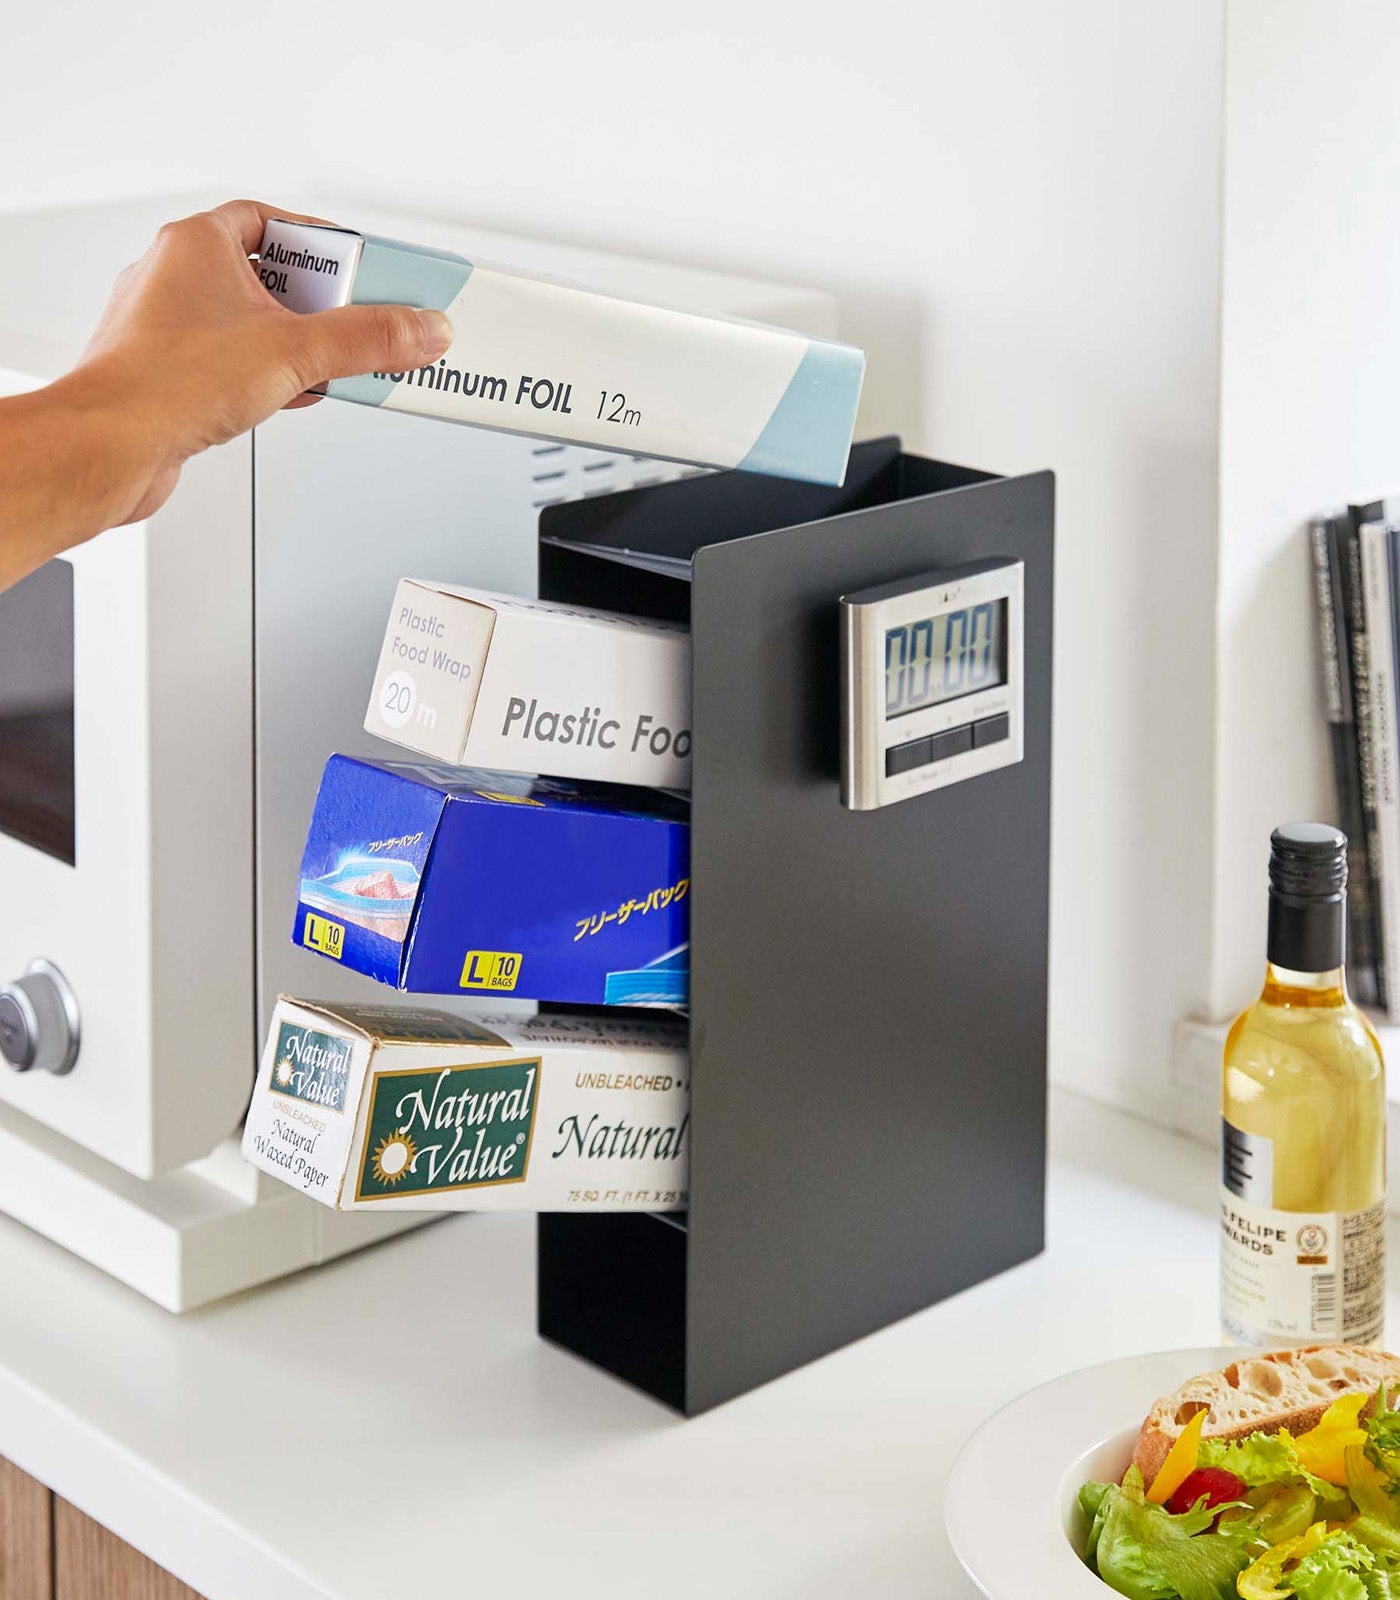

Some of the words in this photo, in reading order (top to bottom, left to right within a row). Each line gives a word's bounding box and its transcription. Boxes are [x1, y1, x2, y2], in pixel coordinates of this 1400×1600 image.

[264, 241, 339, 276] Aluminum
[260, 268, 288, 294] FOIL
[515, 375, 573, 414] FOIL
[597, 390, 641, 426] 12m
[399, 607, 445, 638] Plastic
[391, 636, 429, 666] Food
[432, 649, 472, 682] Wrap
[385, 682, 411, 714] 20
[501, 696, 620, 749] Plastic
[308, 918, 319, 946] L
[328, 925, 340, 945] 10
[324, 943, 340, 956] BAGS
[467, 955, 484, 984] L
[498, 956, 516, 977] 10
[491, 977, 513, 988] BAGS
[286, 1029, 352, 1075] Natural
[289, 1066, 340, 1107] Value
[575, 1073, 673, 1091] UNBLEACHED
[272, 1099, 327, 1134] UNBLEACHED
[395, 1068, 537, 1135] Natural
[271, 1119, 322, 1155] Natural
[552, 1113, 690, 1160] Natural
[253, 1134, 299, 1170] Waxed
[294, 1157, 330, 1189] Paper
[1222, 1221, 1274, 1256] WARDS
[1230, 1213, 1287, 1243] FELIPE
